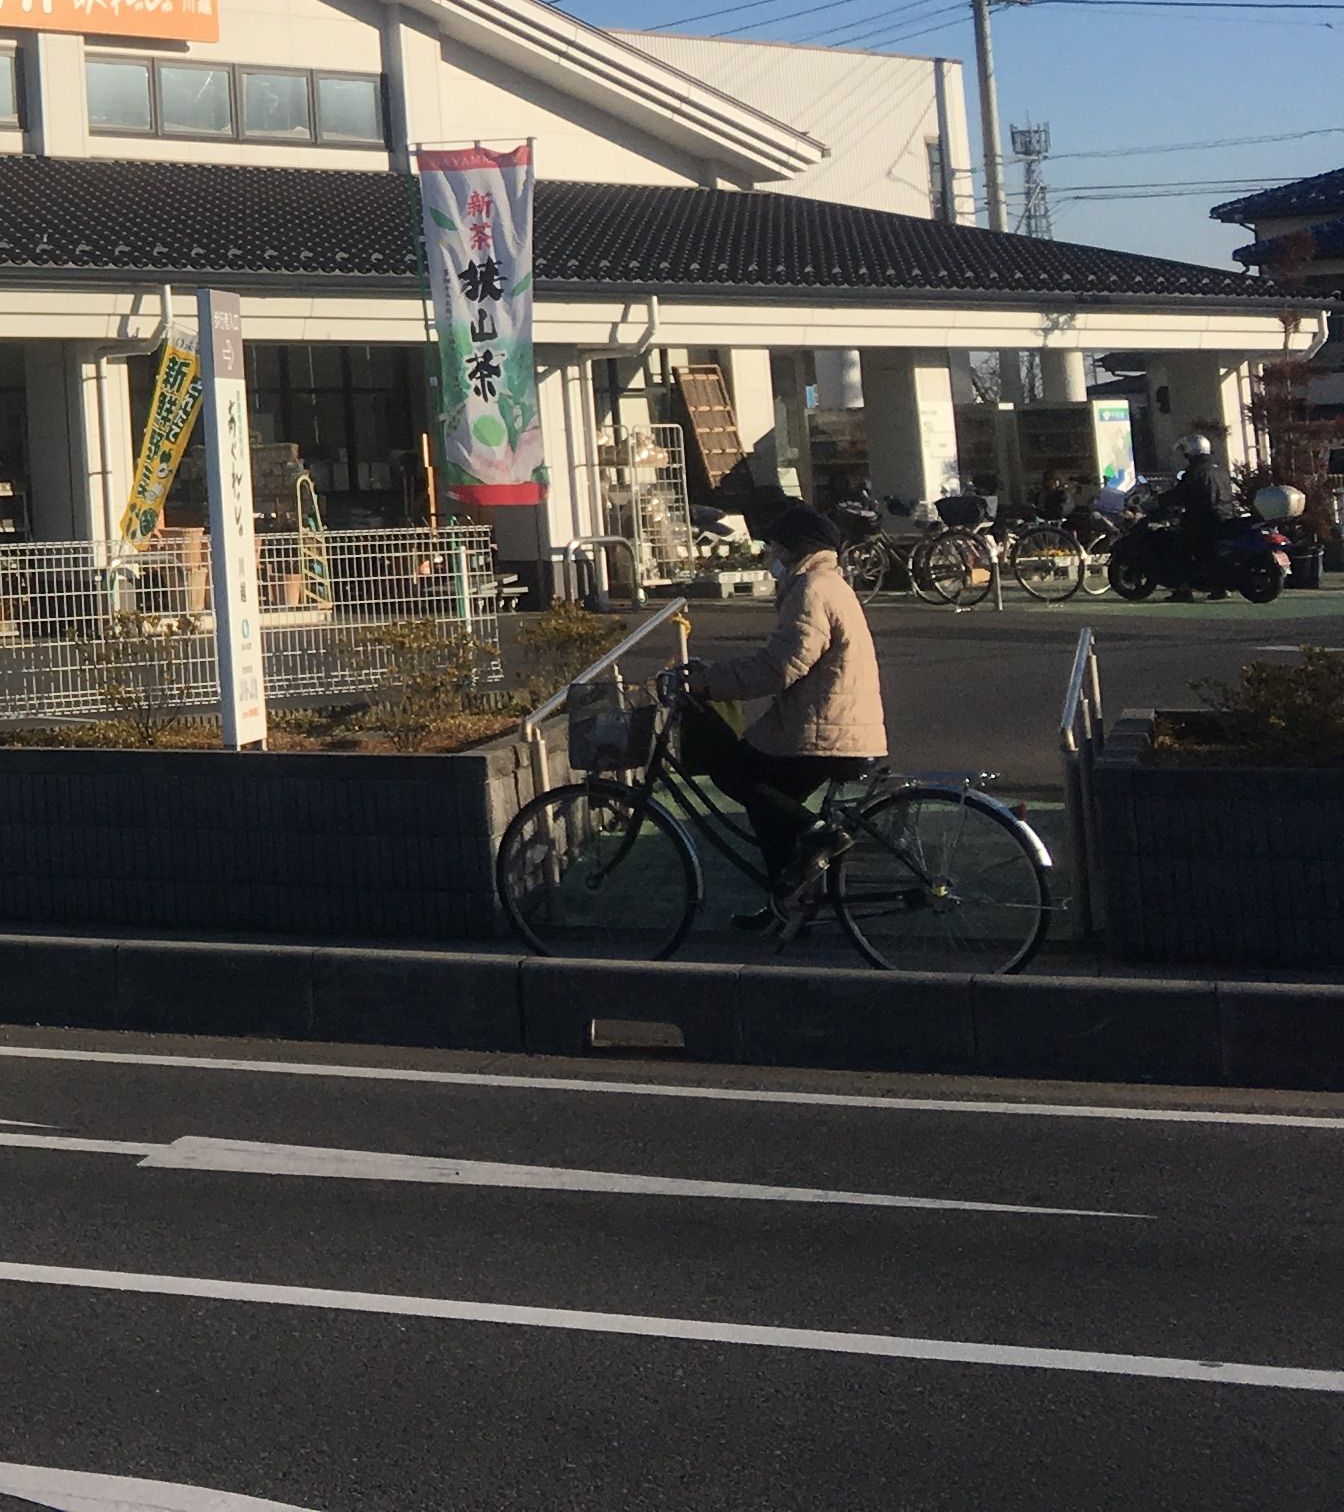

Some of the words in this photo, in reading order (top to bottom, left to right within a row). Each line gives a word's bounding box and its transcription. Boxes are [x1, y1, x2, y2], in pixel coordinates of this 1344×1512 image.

[467, 190, 494, 250] 新茶
[457, 255, 508, 403] 狭山茶
